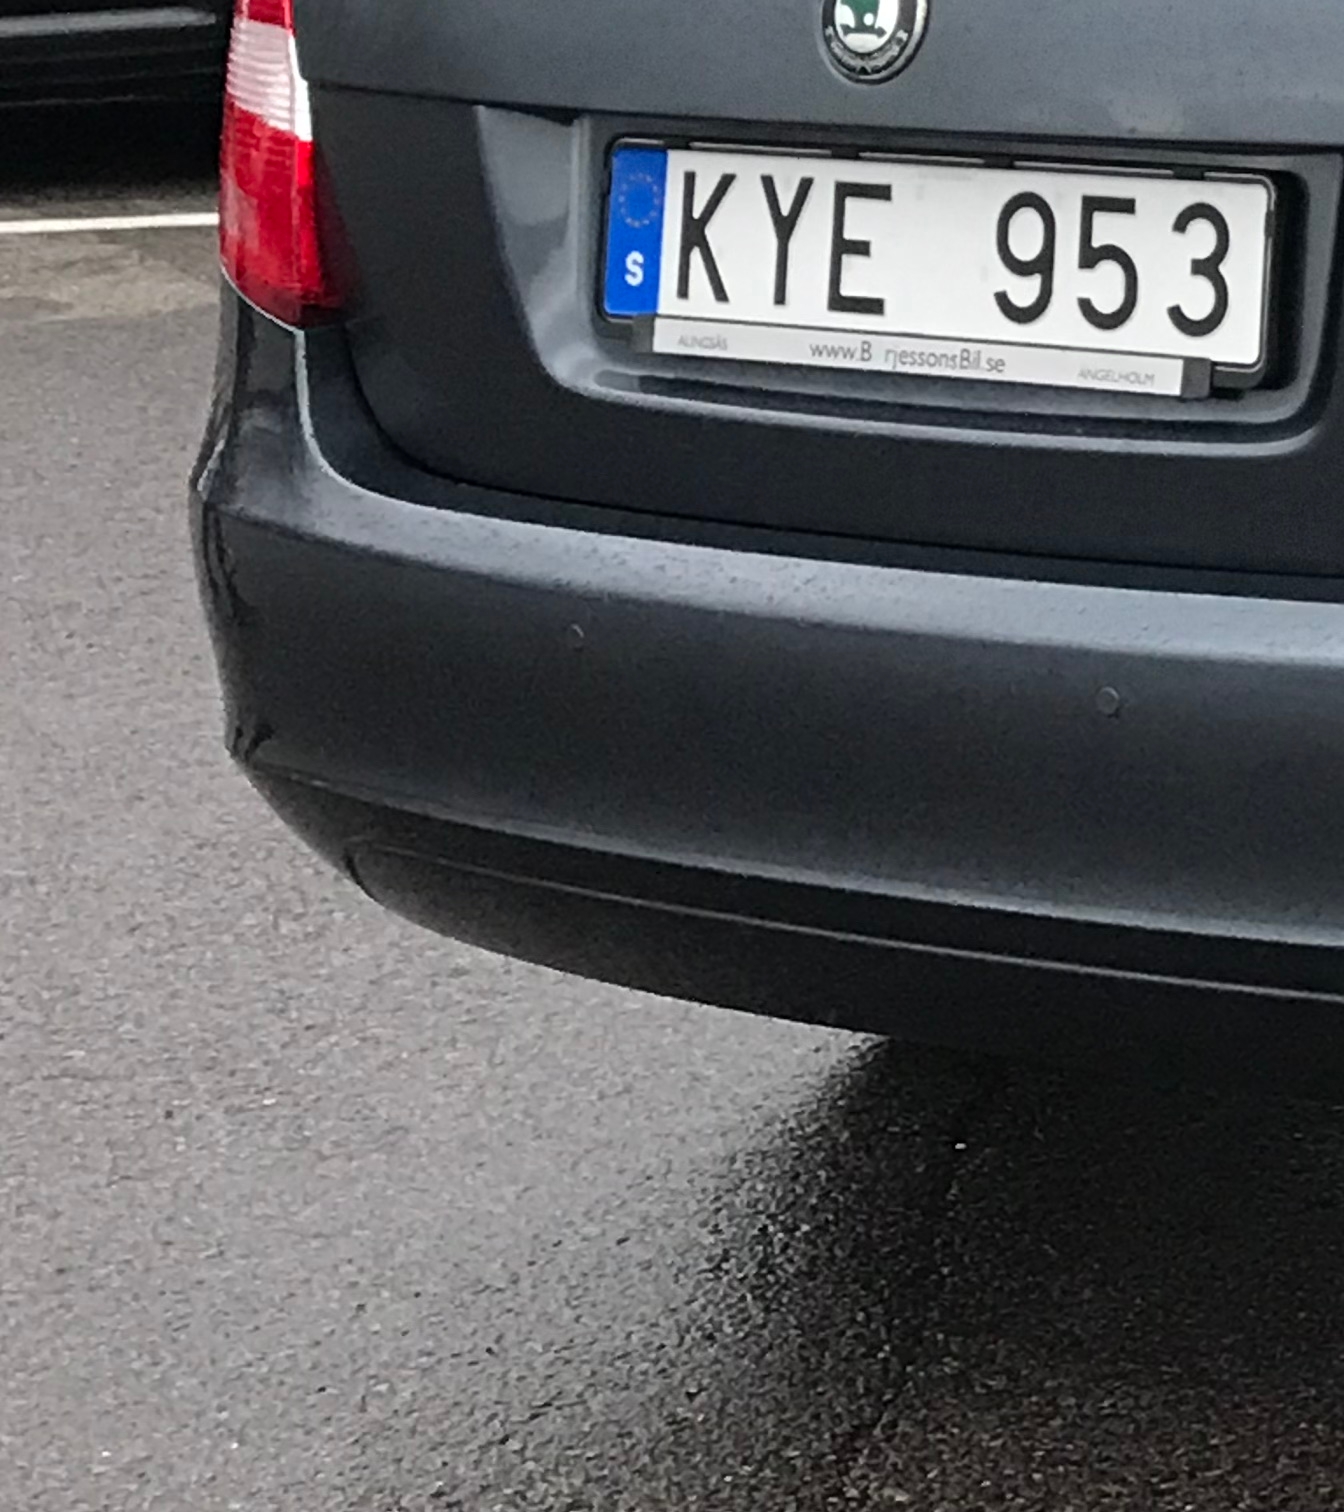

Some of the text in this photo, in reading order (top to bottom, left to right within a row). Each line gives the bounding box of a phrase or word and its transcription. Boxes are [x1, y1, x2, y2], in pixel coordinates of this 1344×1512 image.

[624, 250, 645, 287] S
[675, 170, 1231, 338] KYE 953
